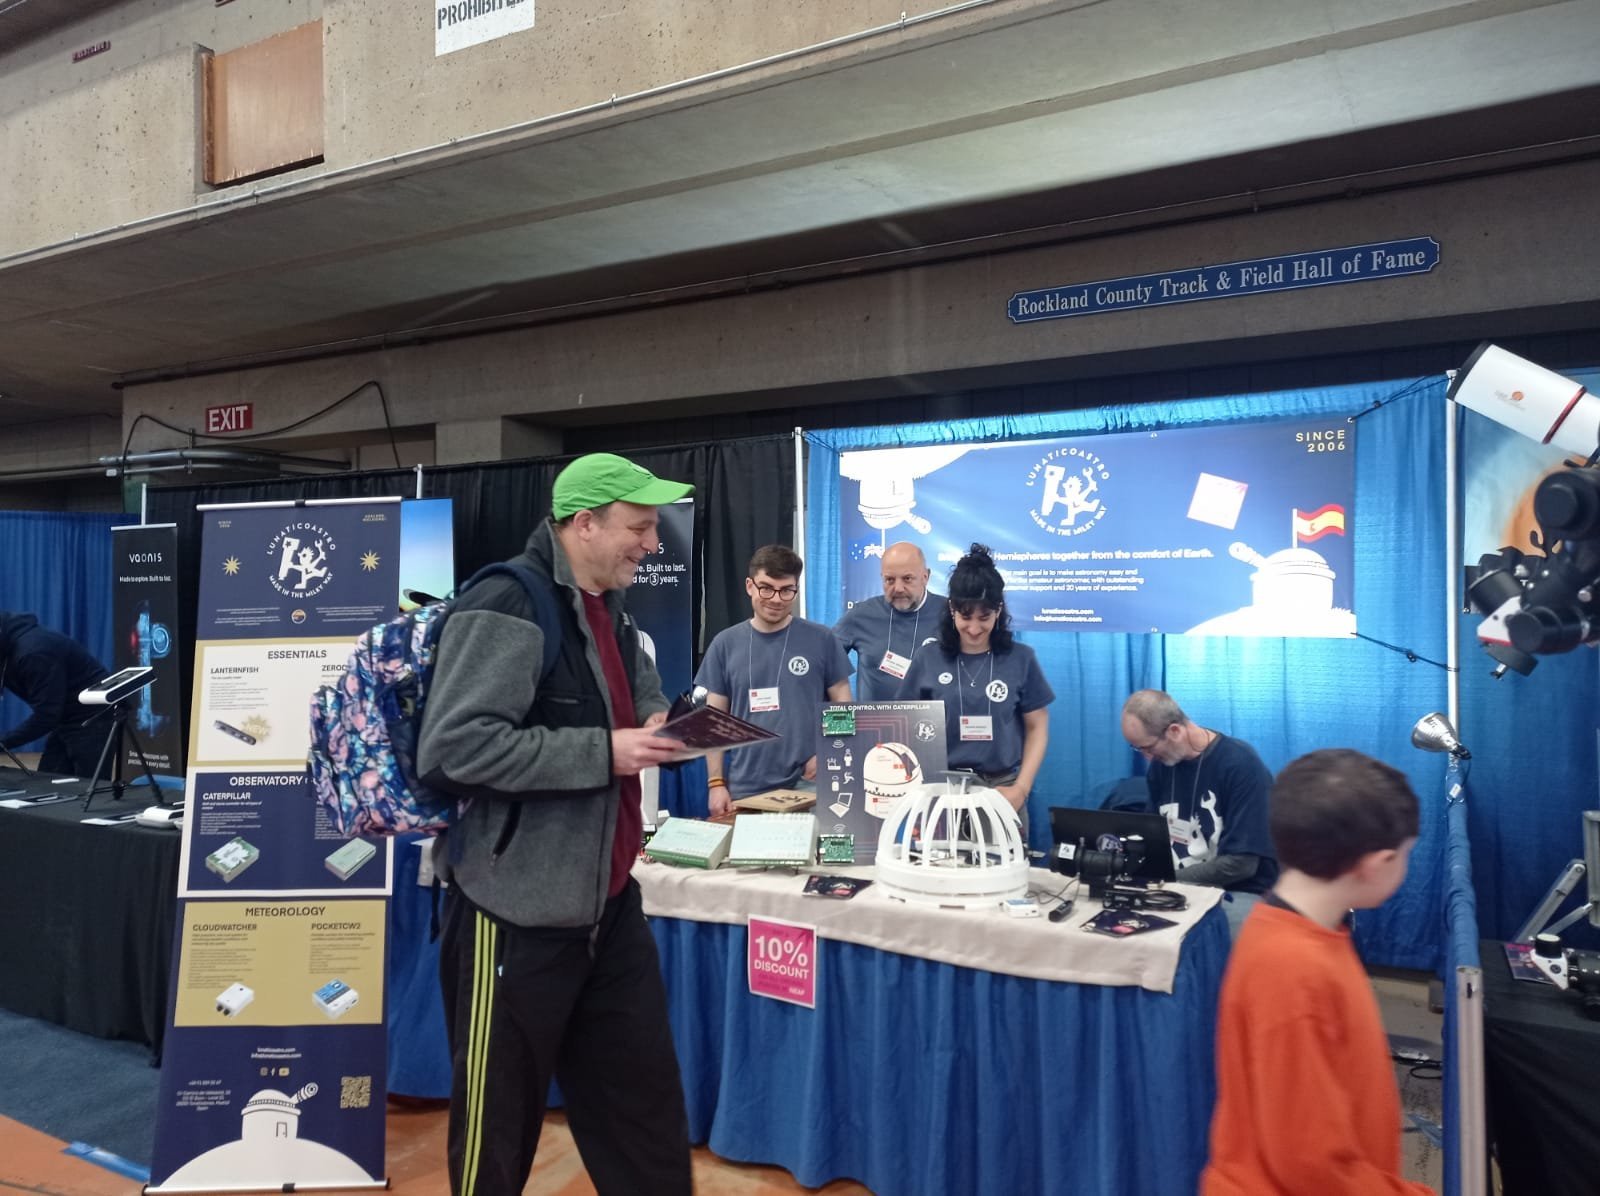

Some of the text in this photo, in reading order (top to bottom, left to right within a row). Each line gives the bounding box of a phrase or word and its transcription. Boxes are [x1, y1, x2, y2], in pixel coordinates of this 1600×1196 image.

[437, 0, 525, 29] PROHIBI
[1018, 250, 1425, 315] Rockland County Track & Field Hall of Fame
[208, 405, 248, 432] EXIT
[1295, 429, 1345, 442] SINCE
[1307, 441, 1345, 453] 2006
[1025, 447, 1110, 487] LUNATICOASTRO
[1029, 509, 1047, 528] MADE
[1046, 525, 1056, 533] IN
[1057, 528, 1071, 536] THE
[267, 522, 336, 555] LUNATICOASTRO
[994, 548, 1214, 562] Hemispheres together from the comfort of Earth.
[646, 563, 664, 572] Built
[664, 564, 672, 572] to
[672, 563, 687, 572] last.
[269, 572, 334, 599] MADE IN THE MILKY WAY
[638, 575, 649, 584] for
[659, 576, 679, 585] years.
[267, 650, 327, 660] ESSENTIALS
[229, 775, 303, 786] OBSERVATORY
[202, 791, 251, 800] CATERPILLAR
[245, 906, 326, 917] METEOROLOGY
[192, 923, 257, 932] CLOUDWATCHER
[311, 922, 361, 930] POCKETCW2
[755, 935, 808, 967] 10%
[754, 959, 809, 980] DISCOUNT
